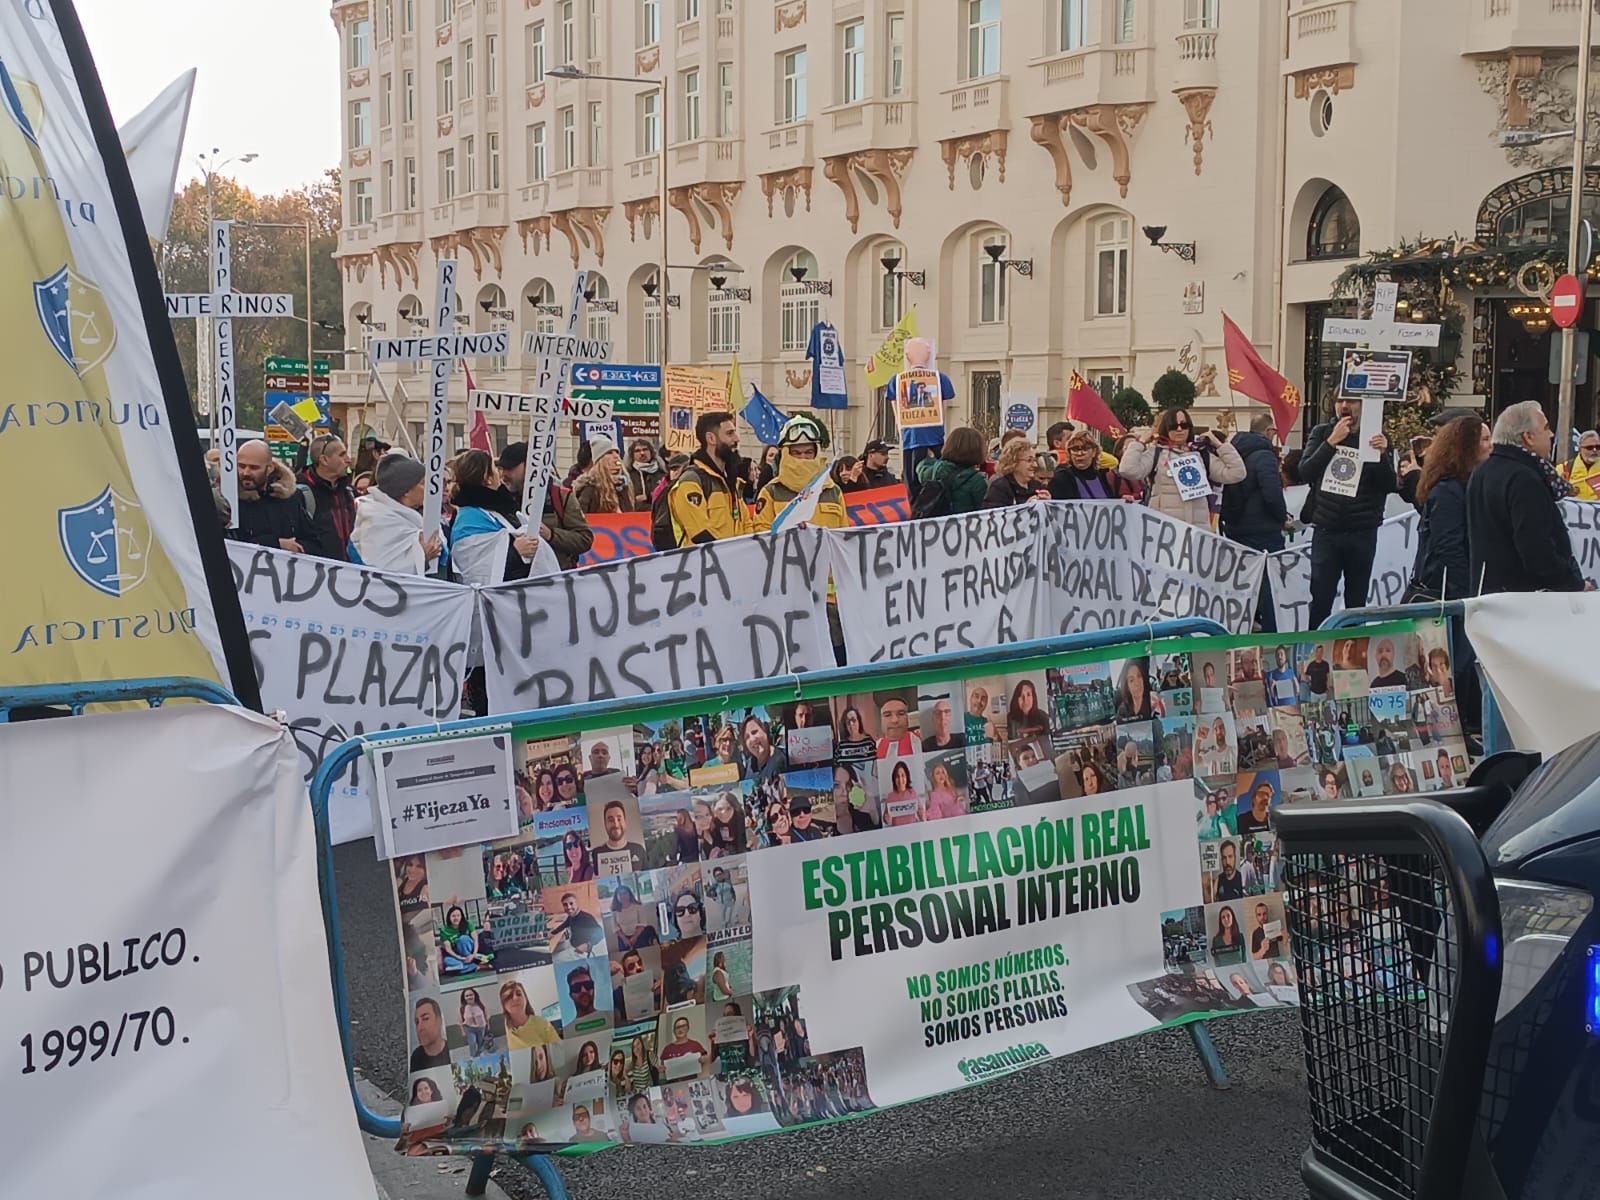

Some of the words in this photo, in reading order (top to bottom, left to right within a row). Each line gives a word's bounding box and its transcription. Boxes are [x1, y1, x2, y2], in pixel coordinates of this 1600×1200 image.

[166, 294, 287, 314] NTERINOS
[376, 331, 507, 360] INTERINOS
[528, 335, 609, 360] INTERINOS
[476, 393, 610, 419] INTERNOS
[1141, 513, 1256, 591] FRAUDE
[884, 577, 928, 628] EN
[296, 632, 467, 718] PLAZAS
[1388, 695, 1404, 709] 75
[801, 816, 1075, 910] ESTABILIZACIÓN
[1081, 804, 1151, 860] REAL
[828, 880, 1011, 962] PERSONAL
[1016, 856, 1141, 926] INTERNO
[706, 925, 752, 941] WANTED
[23, 927, 200, 992] PUBLICO.
[906, 973, 932, 1000] NO
[935, 961, 990, 994] SOMOS
[920, 1000, 943, 1024] NO
[945, 987, 1000, 1018] SOMOS
[924, 1015, 981, 1048] SOMOS
[984, 994, 1068, 1035] PERSONAS
[20, 1006, 190, 1075] 1999/70.
